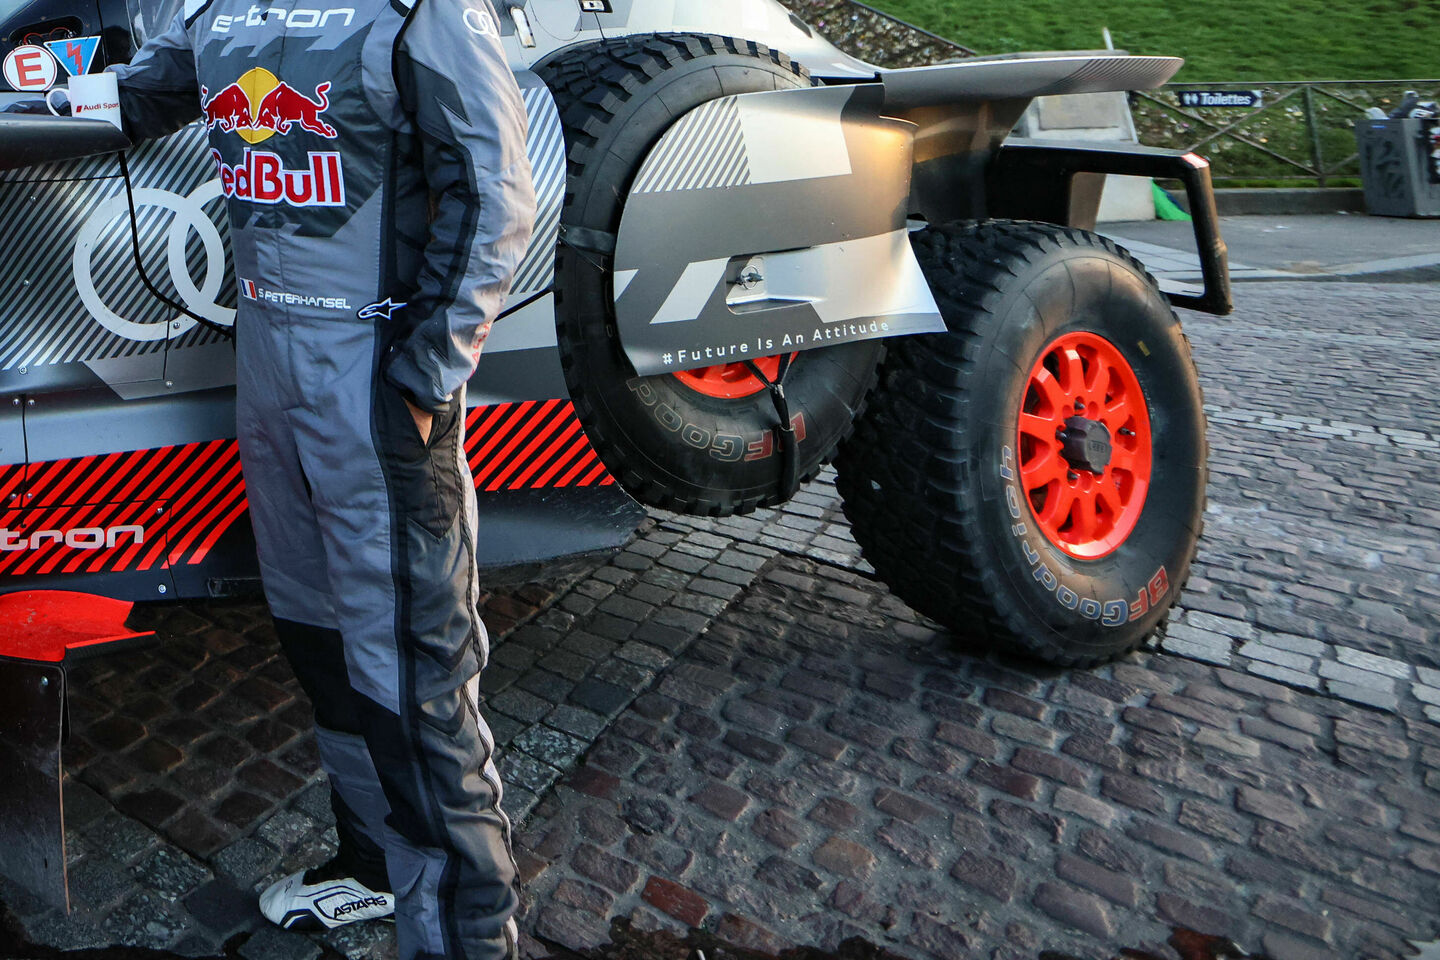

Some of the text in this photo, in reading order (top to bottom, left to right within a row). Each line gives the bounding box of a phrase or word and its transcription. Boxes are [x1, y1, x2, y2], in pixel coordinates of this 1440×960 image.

[211, 4, 356, 33] e-tron
[14, 52, 46, 87] E
[1200, 92, 1252, 105] Toilettes
[252, 151, 346, 207] Bull
[258, 288, 352, 309] S PETERHANSEL
[662, 320, 890, 365] #Future Is An Attitude
[1000, 445, 1170, 627] BFGoodrich
[333, 895, 388, 920] ASTARS
